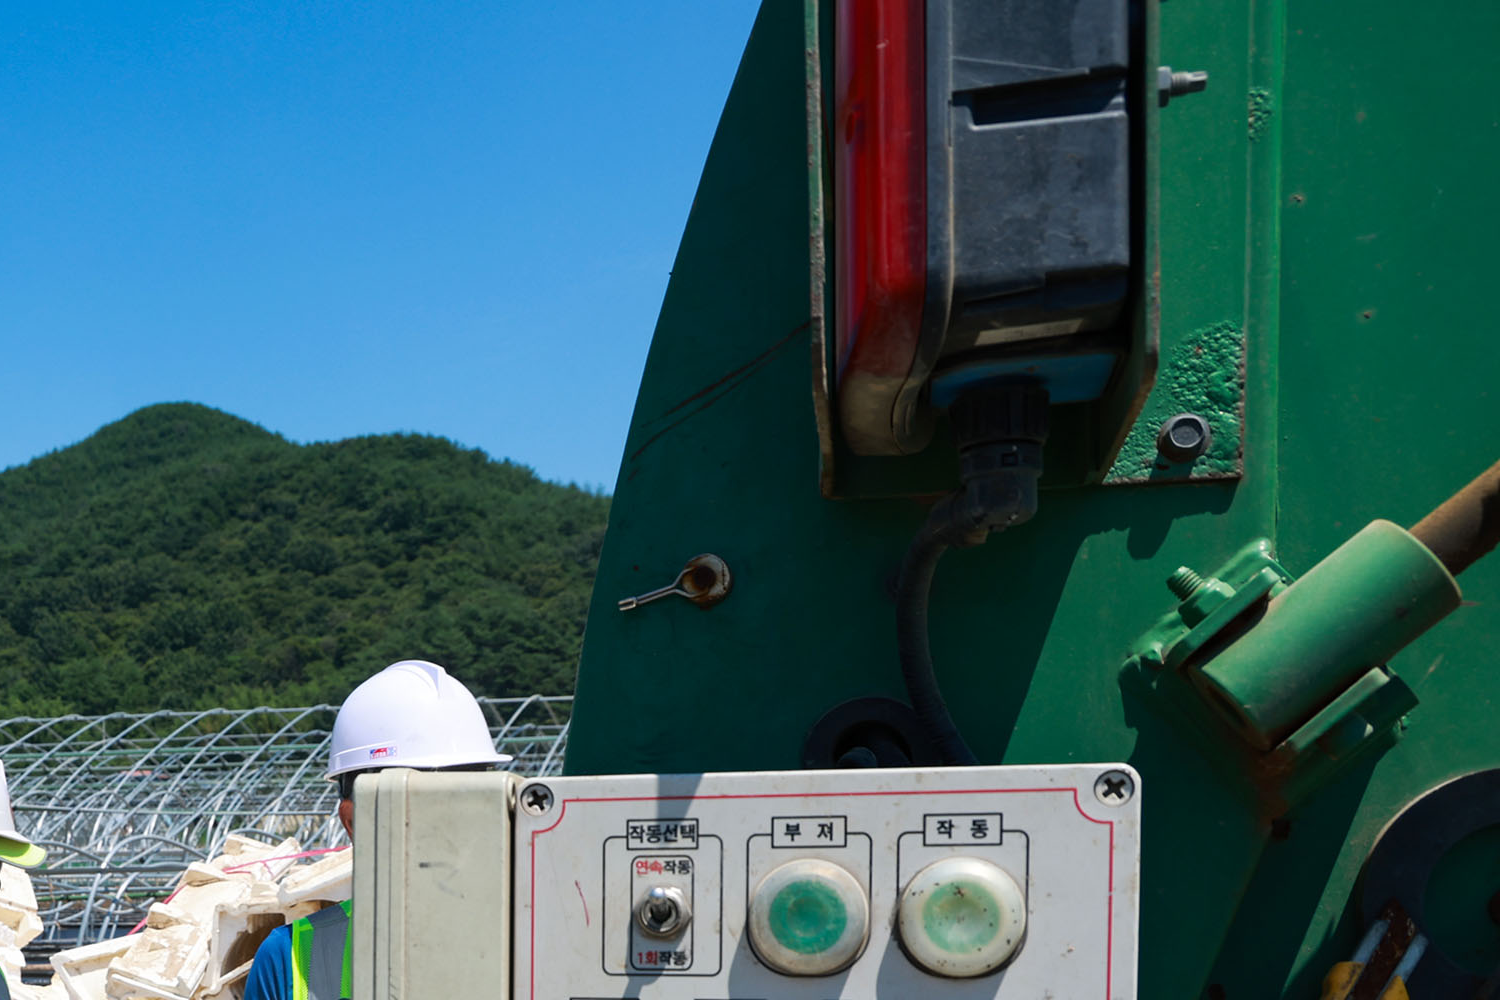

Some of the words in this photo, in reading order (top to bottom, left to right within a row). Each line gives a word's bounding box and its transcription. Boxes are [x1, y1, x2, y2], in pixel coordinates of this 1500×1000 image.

[628, 823, 696, 844] 작동선택
[935, 818, 990, 840] 작동
[635, 859, 692, 876] 연속작동
[636, 950, 688, 967] 1회작동
